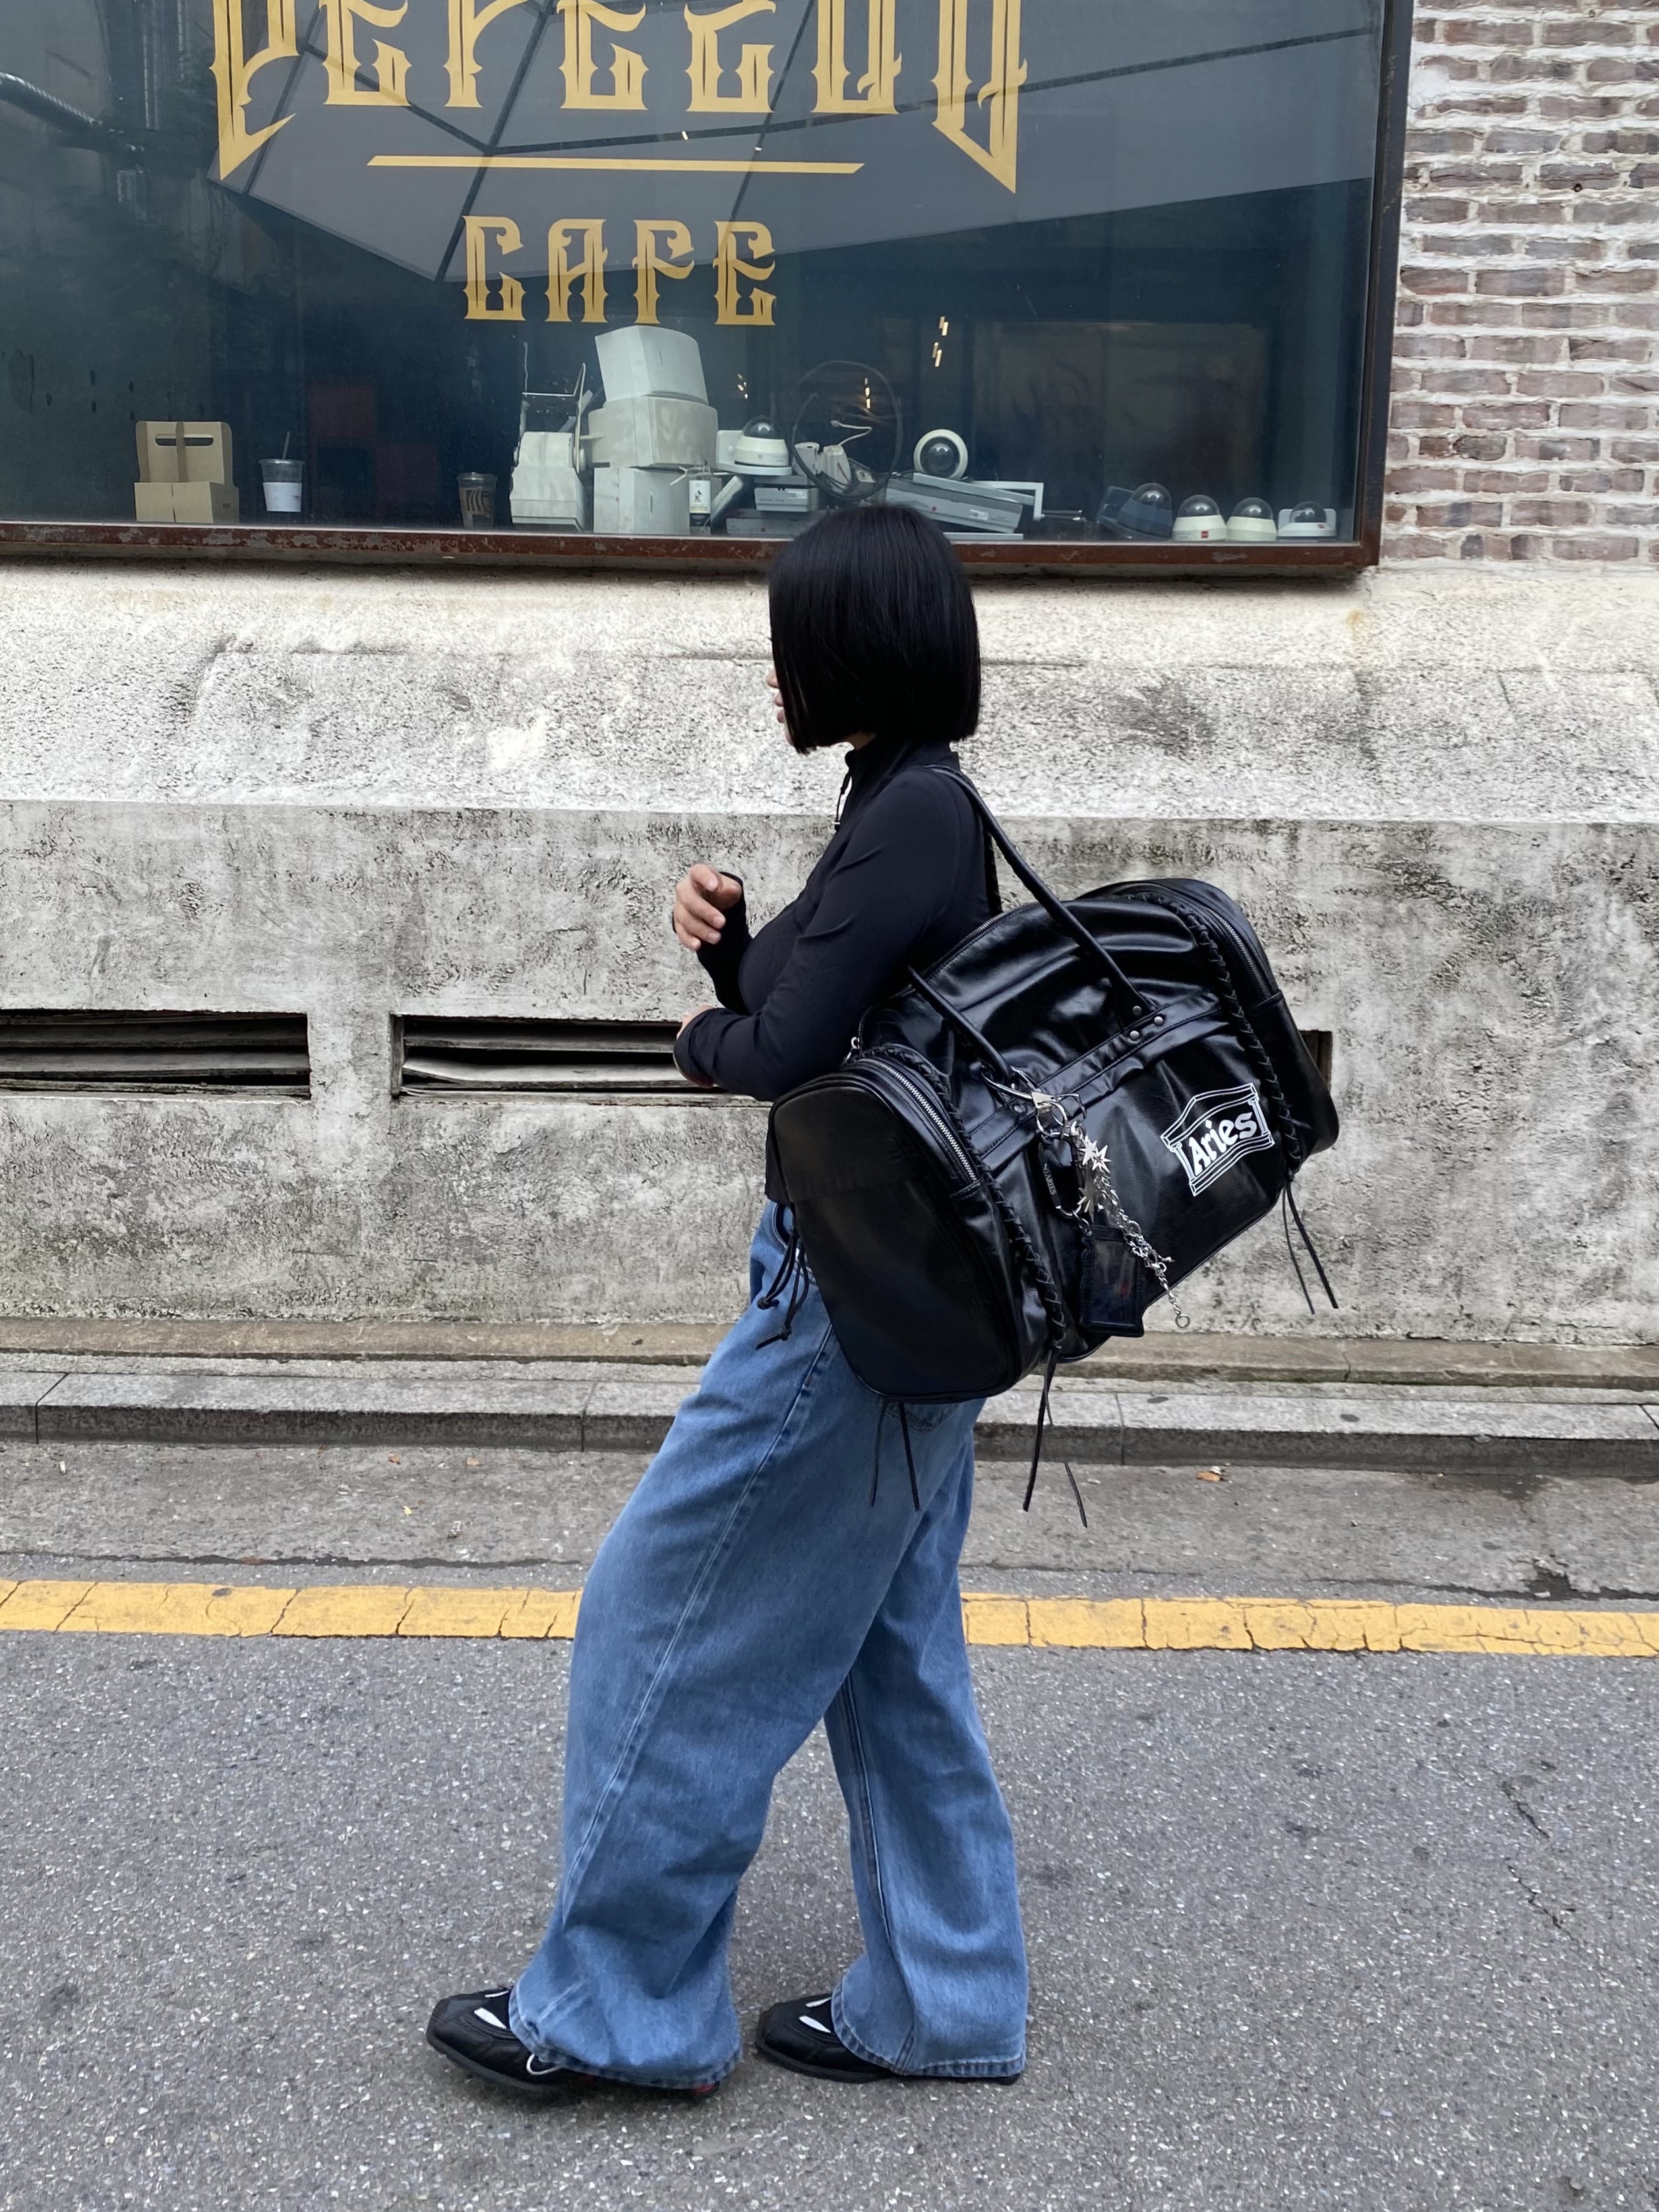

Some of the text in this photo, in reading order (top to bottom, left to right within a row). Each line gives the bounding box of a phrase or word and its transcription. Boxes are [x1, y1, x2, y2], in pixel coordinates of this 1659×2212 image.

[462, 215, 777, 326] CAFE
[1189, 1112, 1257, 1175] Aries
[1044, 1174, 1057, 1195] ARIES
